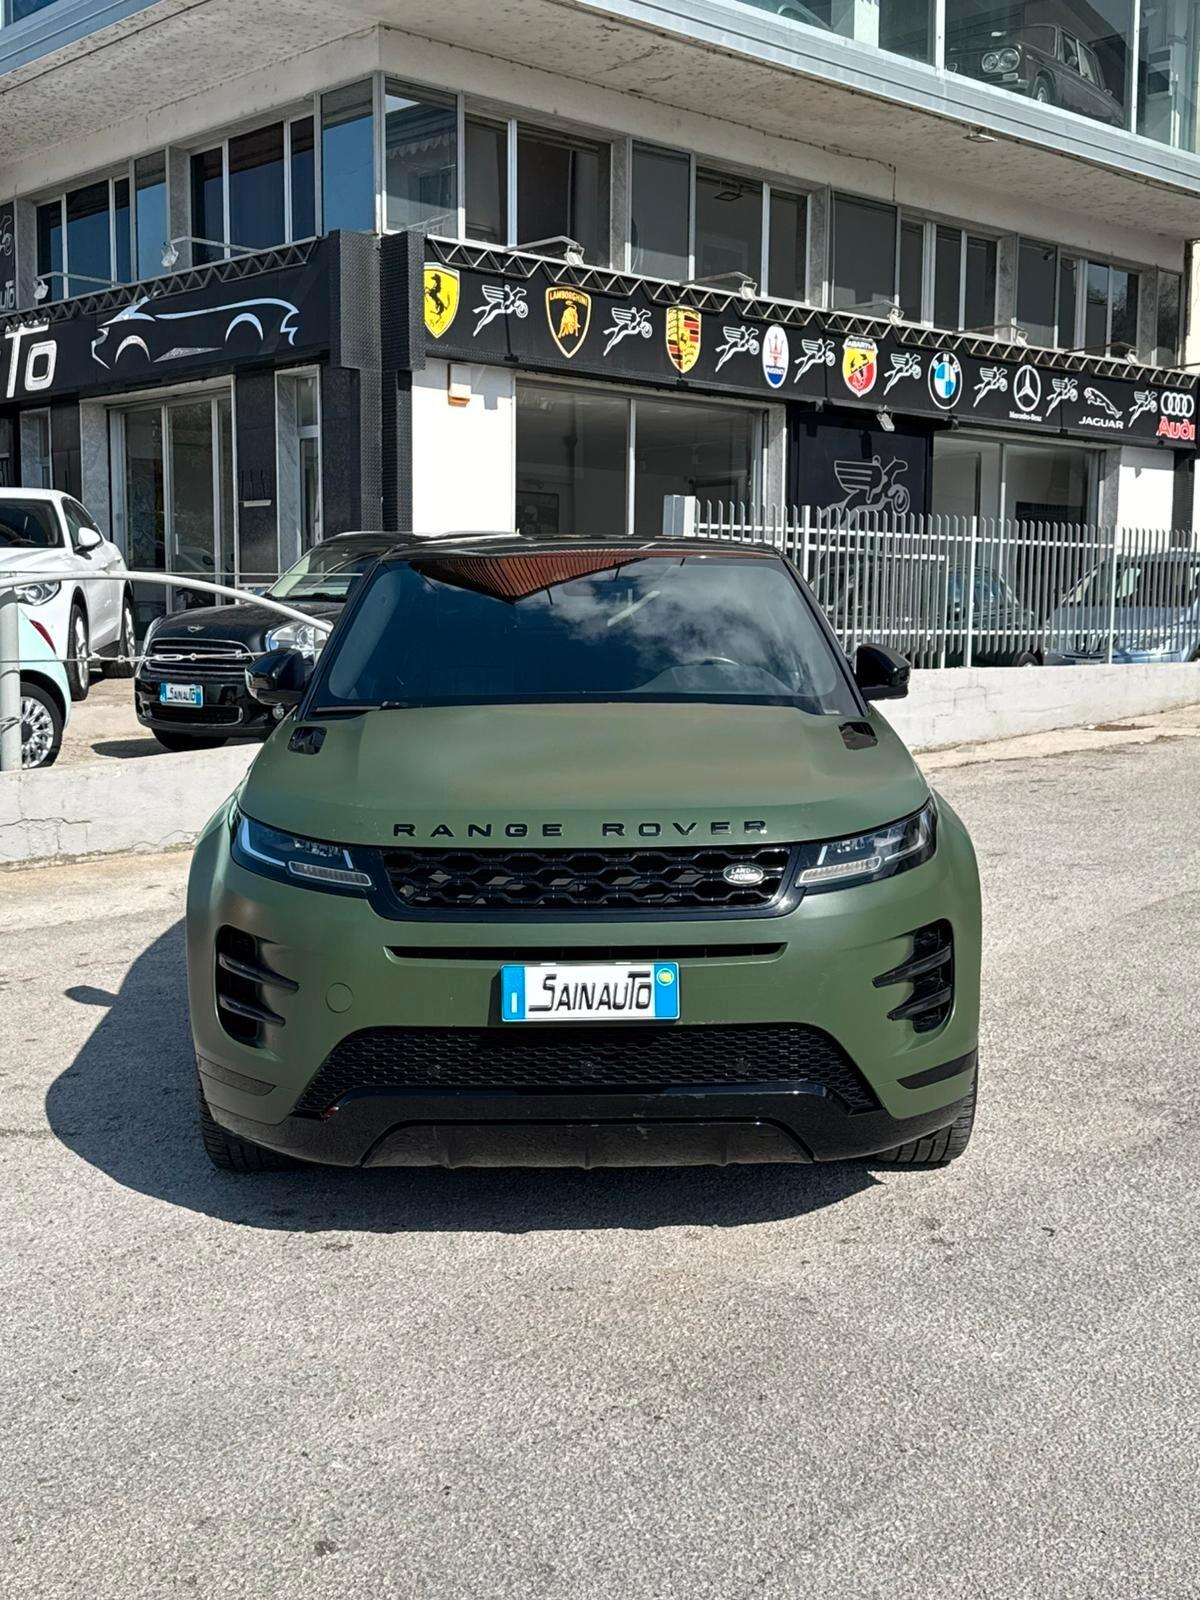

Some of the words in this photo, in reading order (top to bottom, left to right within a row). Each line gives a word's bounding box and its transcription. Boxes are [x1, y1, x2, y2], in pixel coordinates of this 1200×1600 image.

[1078, 416, 1124, 429] JAGUAR
[1156, 416, 1196, 440] Audi
[393, 823, 562, 837] RANGE
[602, 820, 767, 837] ROVER
[528, 971, 651, 1011] SAINAUTO
